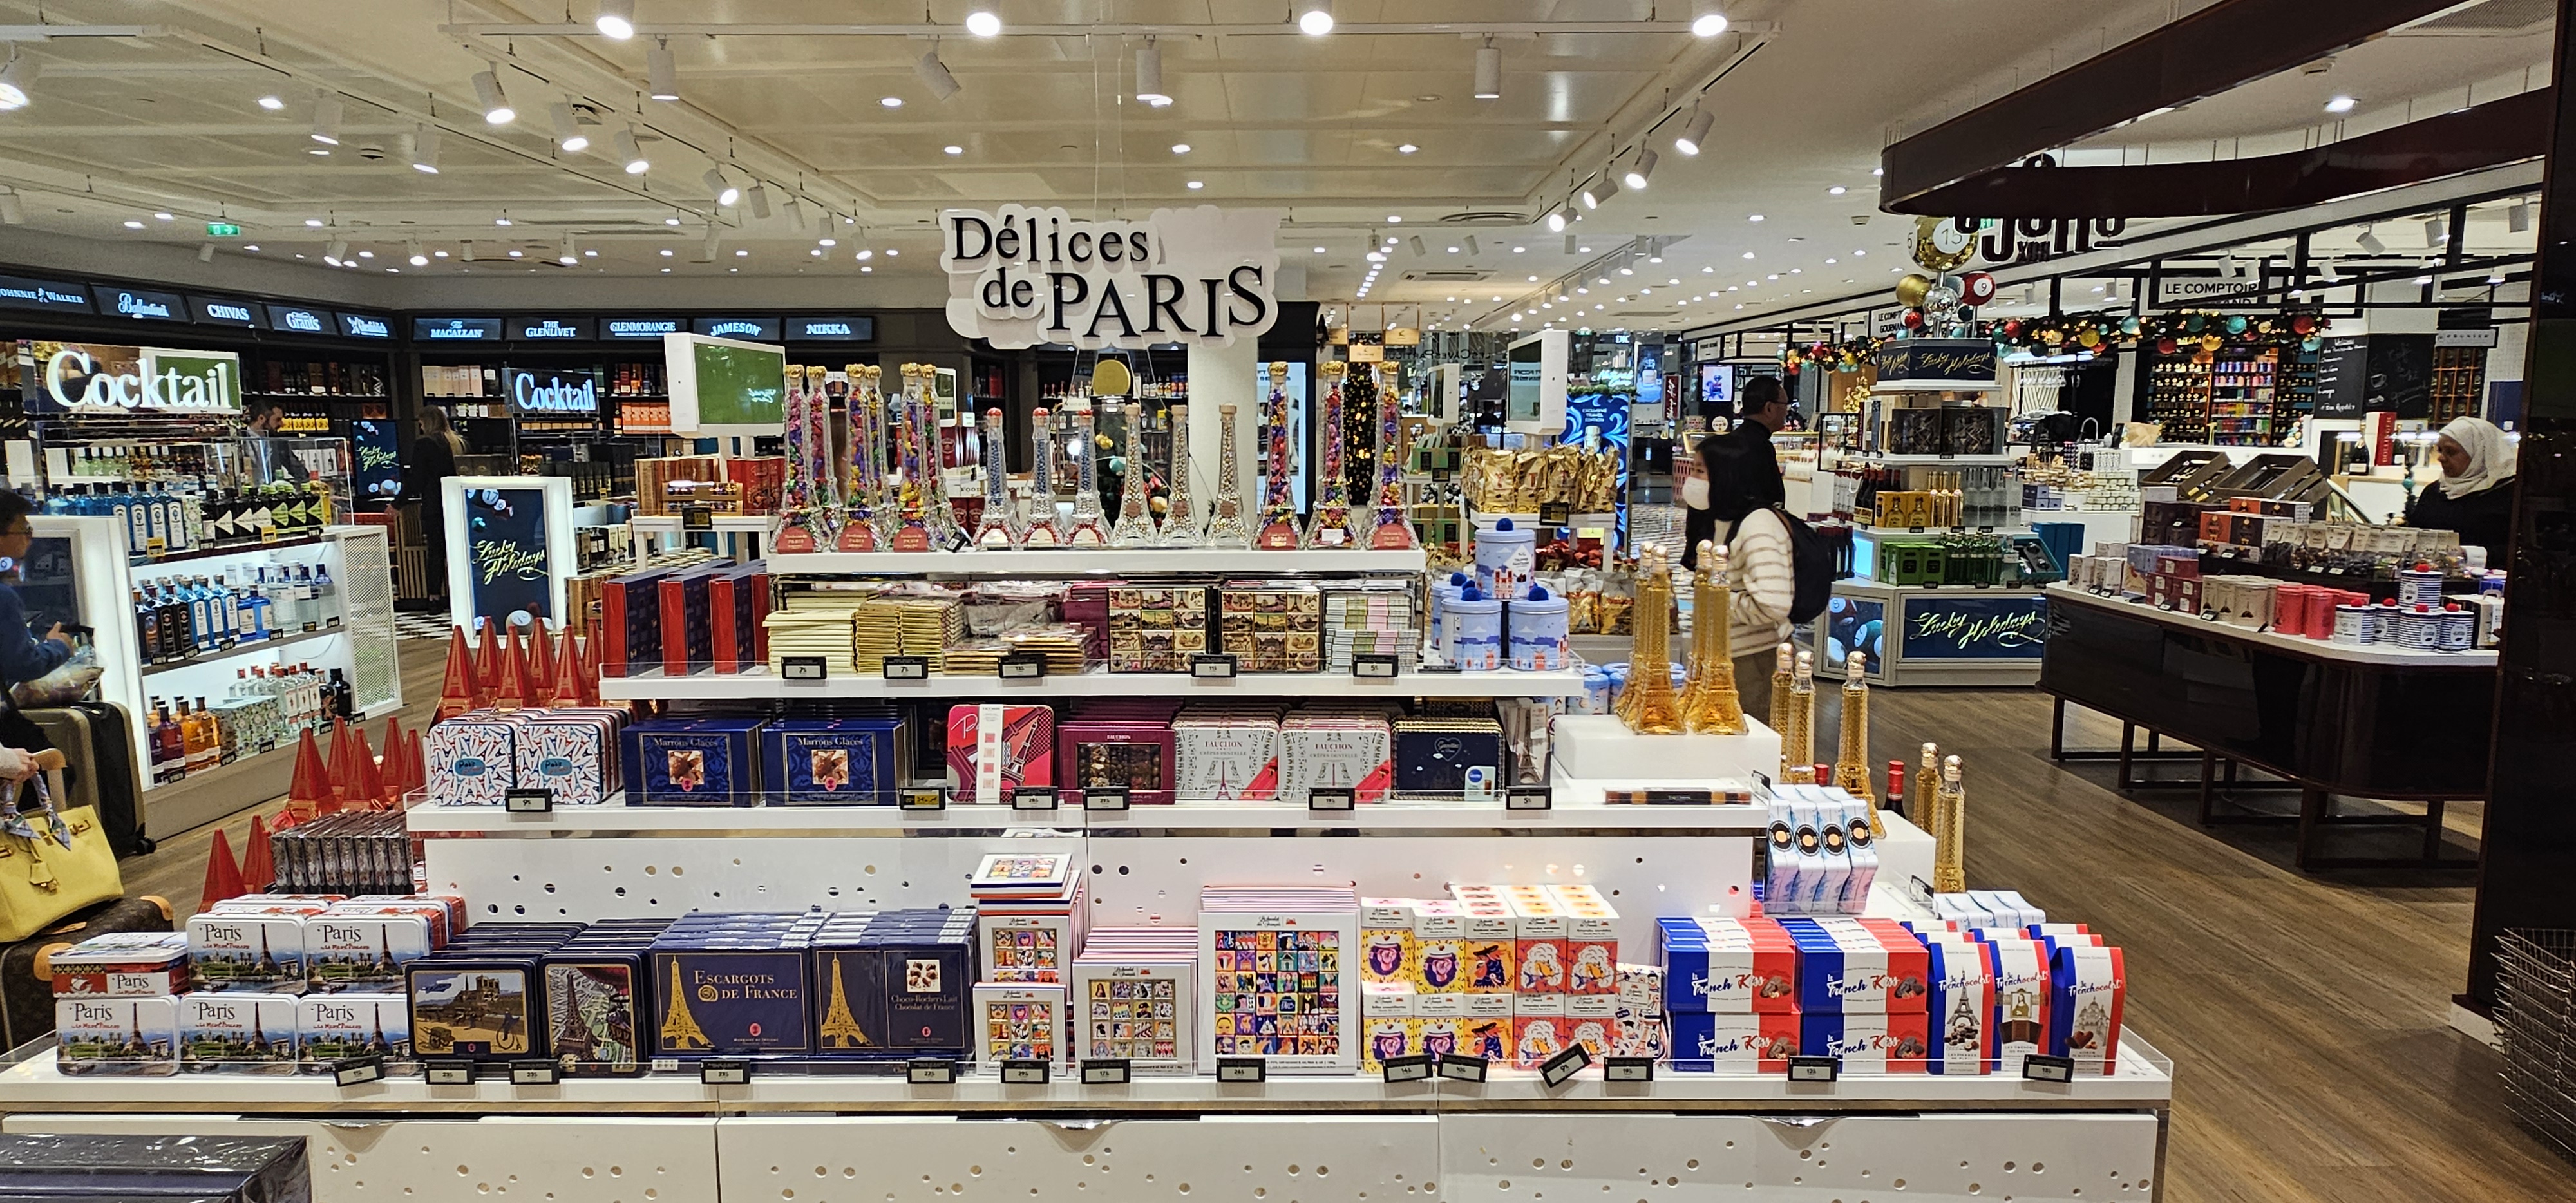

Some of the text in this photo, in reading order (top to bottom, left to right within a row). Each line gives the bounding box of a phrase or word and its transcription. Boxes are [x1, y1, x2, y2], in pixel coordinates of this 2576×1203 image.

[950, 214, 1149, 263] Délices
[1940, 228, 1962, 245] 15
[1980, 282, 1987, 292] 9
[2165, 283, 2257, 294] LE COMPTOIR
[46, 292, 84, 303] WALKER
[982, 265, 1266, 338] de PARIS
[207, 304, 250, 321] CHIVAS
[430, 329, 484, 338] MACALLAN
[526, 327, 576, 337] GLENLIVET
[610, 321, 676, 332] GLENMORANGIE
[710, 322, 761, 337] JAMESON
[806, 324, 851, 334] NIKKA
[46, 350, 232, 409] Cocktail
[515, 372, 598, 413] Cocktail
[486, 491, 498, 502] 17
[469, 540, 516, 564] Lucky
[483, 549, 549, 585] Holidays
[1906, 610, 2043, 649] Lucky Holidays
[654, 737, 718, 747] Marrons Glacés
[798, 737, 863, 746] Marrons Glacés
[204, 924, 242, 942] Paris
[322, 924, 362, 943] Paris
[117, 974, 149, 989] Paris
[694, 970, 774, 985] ESCARGOTS
[721, 985, 797, 999] DE FRANCE
[1691, 977, 1733, 996] French
[1826, 978, 1868, 998] French
[75, 1003, 113, 1021] Paris
[198, 1002, 235, 1020] Paris
[316, 1003, 354, 1022] Paris
[1698, 1039, 1739, 1058] French
[1826, 1039, 1868, 1058] French
